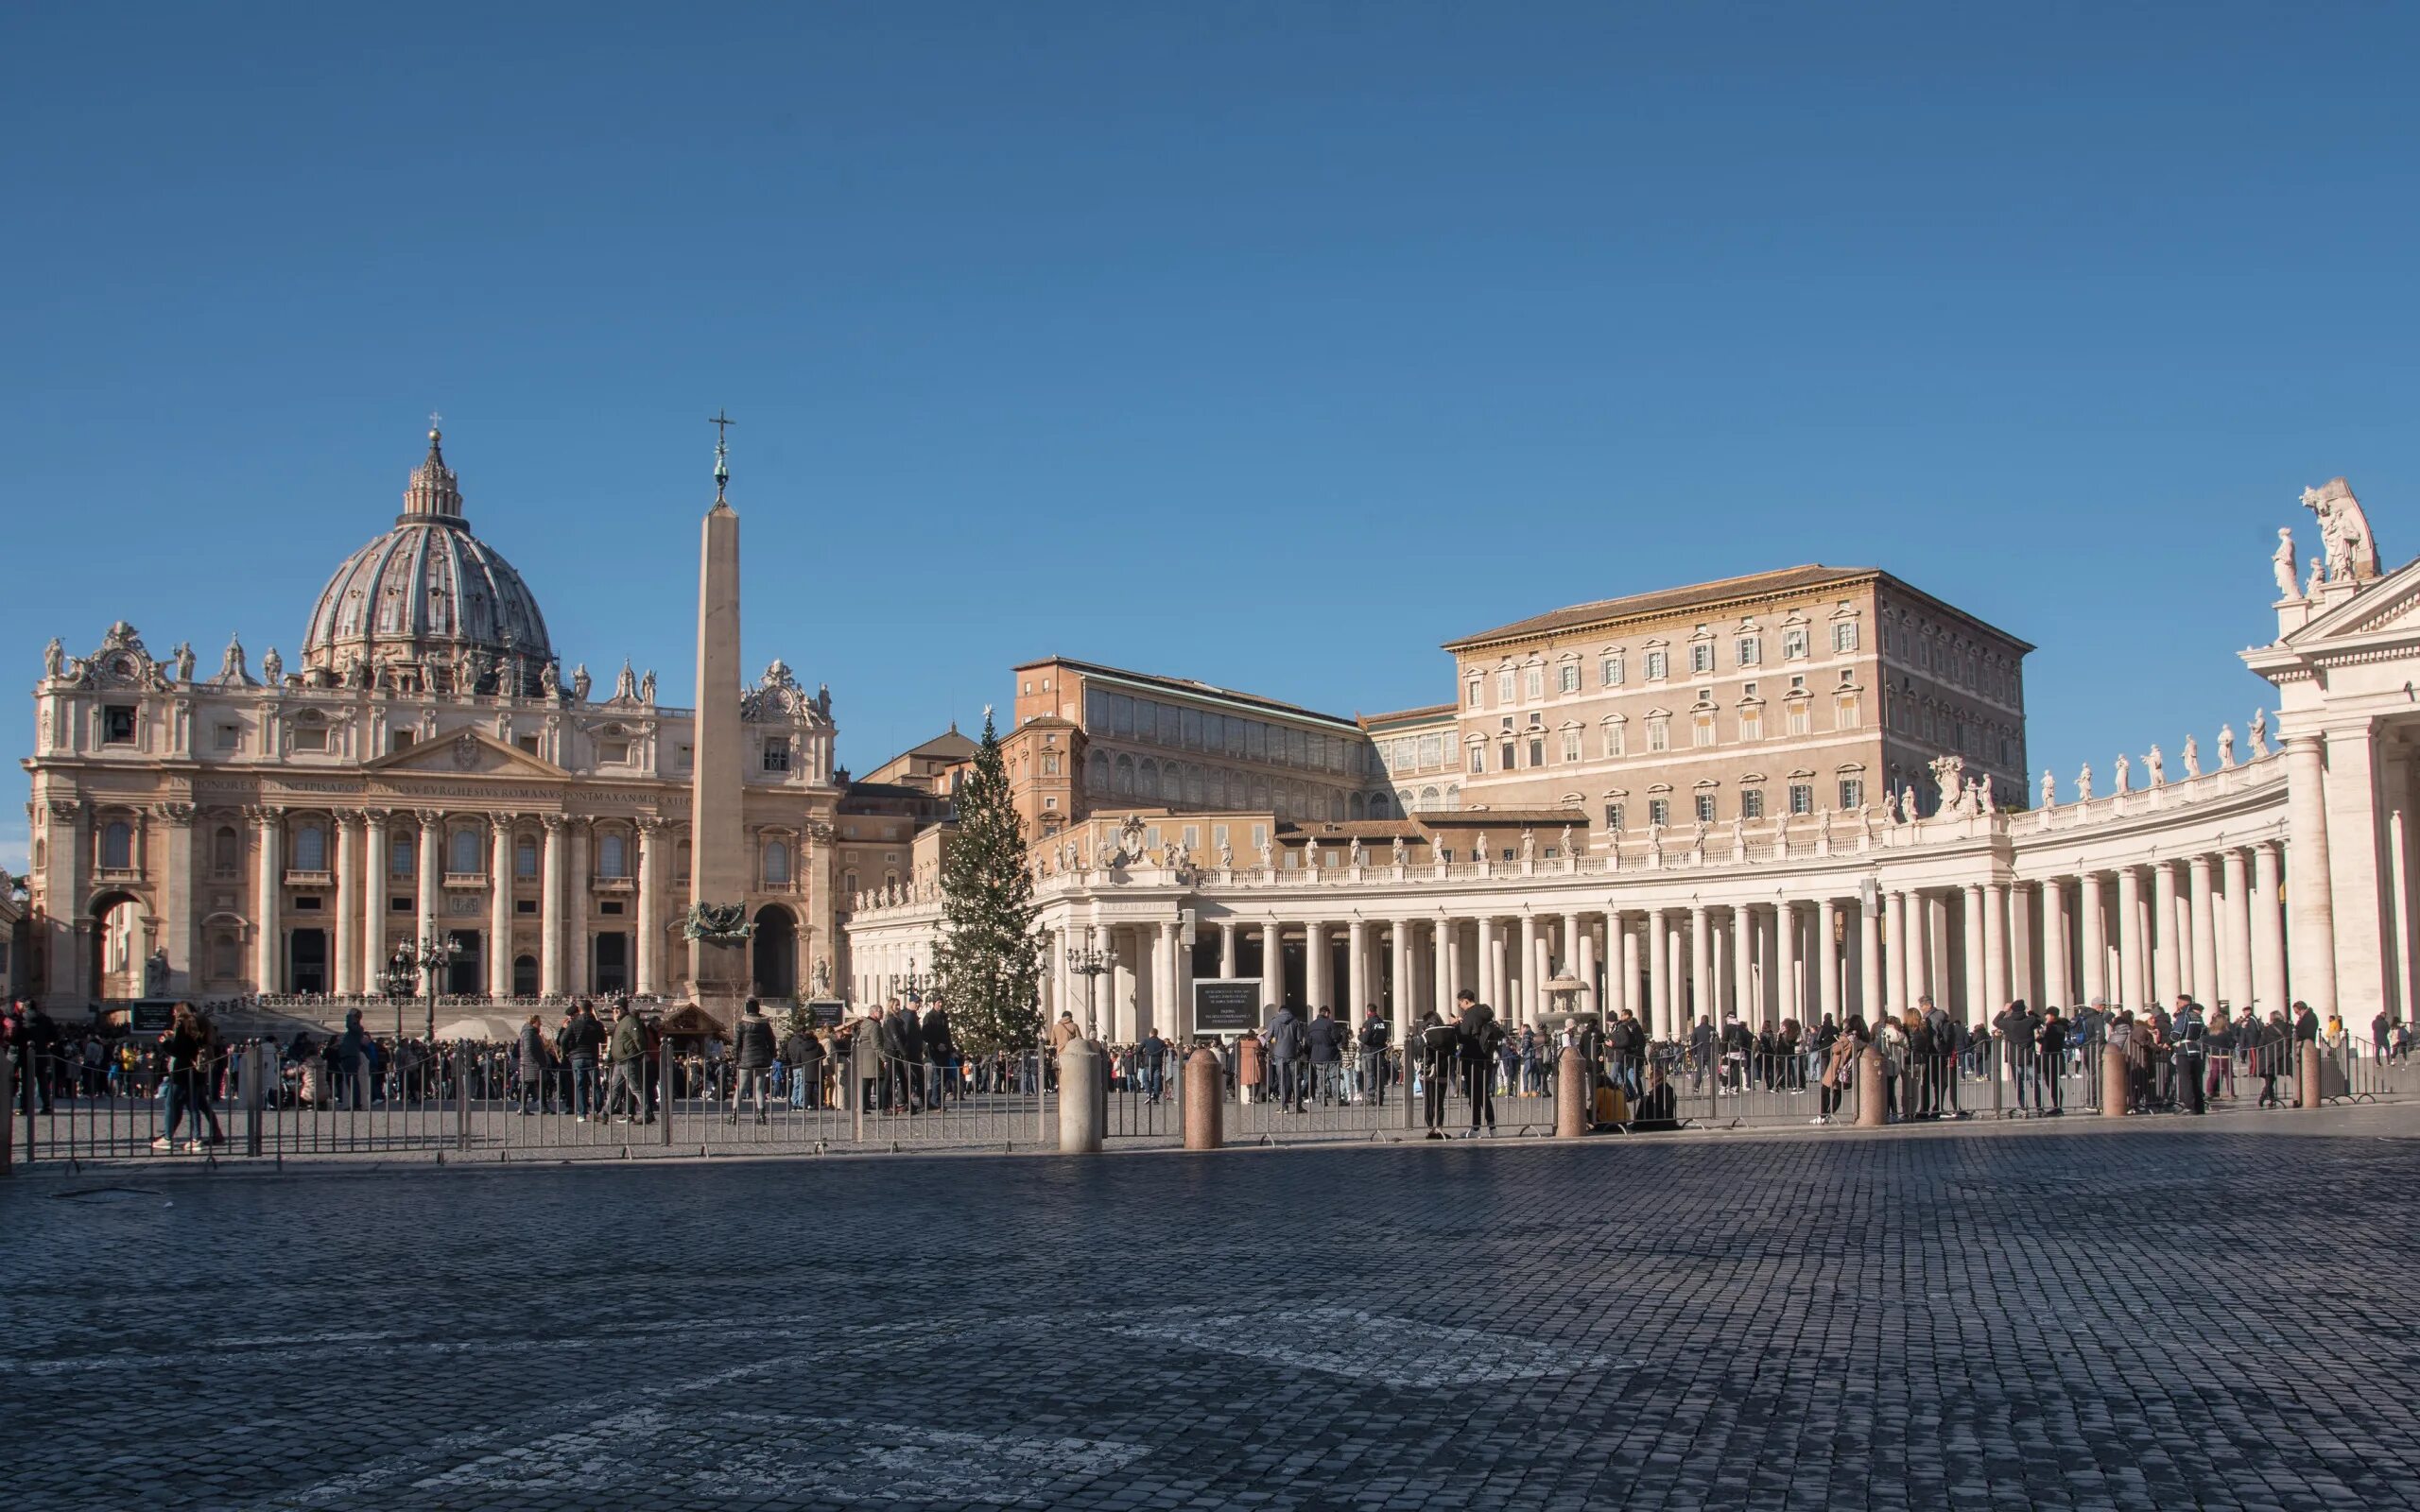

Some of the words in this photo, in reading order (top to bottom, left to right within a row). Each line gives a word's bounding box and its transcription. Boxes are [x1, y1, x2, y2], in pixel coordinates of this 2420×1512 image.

[171, 776, 186, 787] IN
[194, 779, 259, 791] HONOREM
[262, 780, 327, 792] PRINCIPIS
[328, 782, 367, 794] APOST
[369, 782, 412, 795] PAVLVS
[423, 785, 499, 797] BVRGHESIVS
[501, 788, 562, 799] ROMANVS
[563, 790, 595, 801] PONT
[595, 792, 620, 802] MAX
